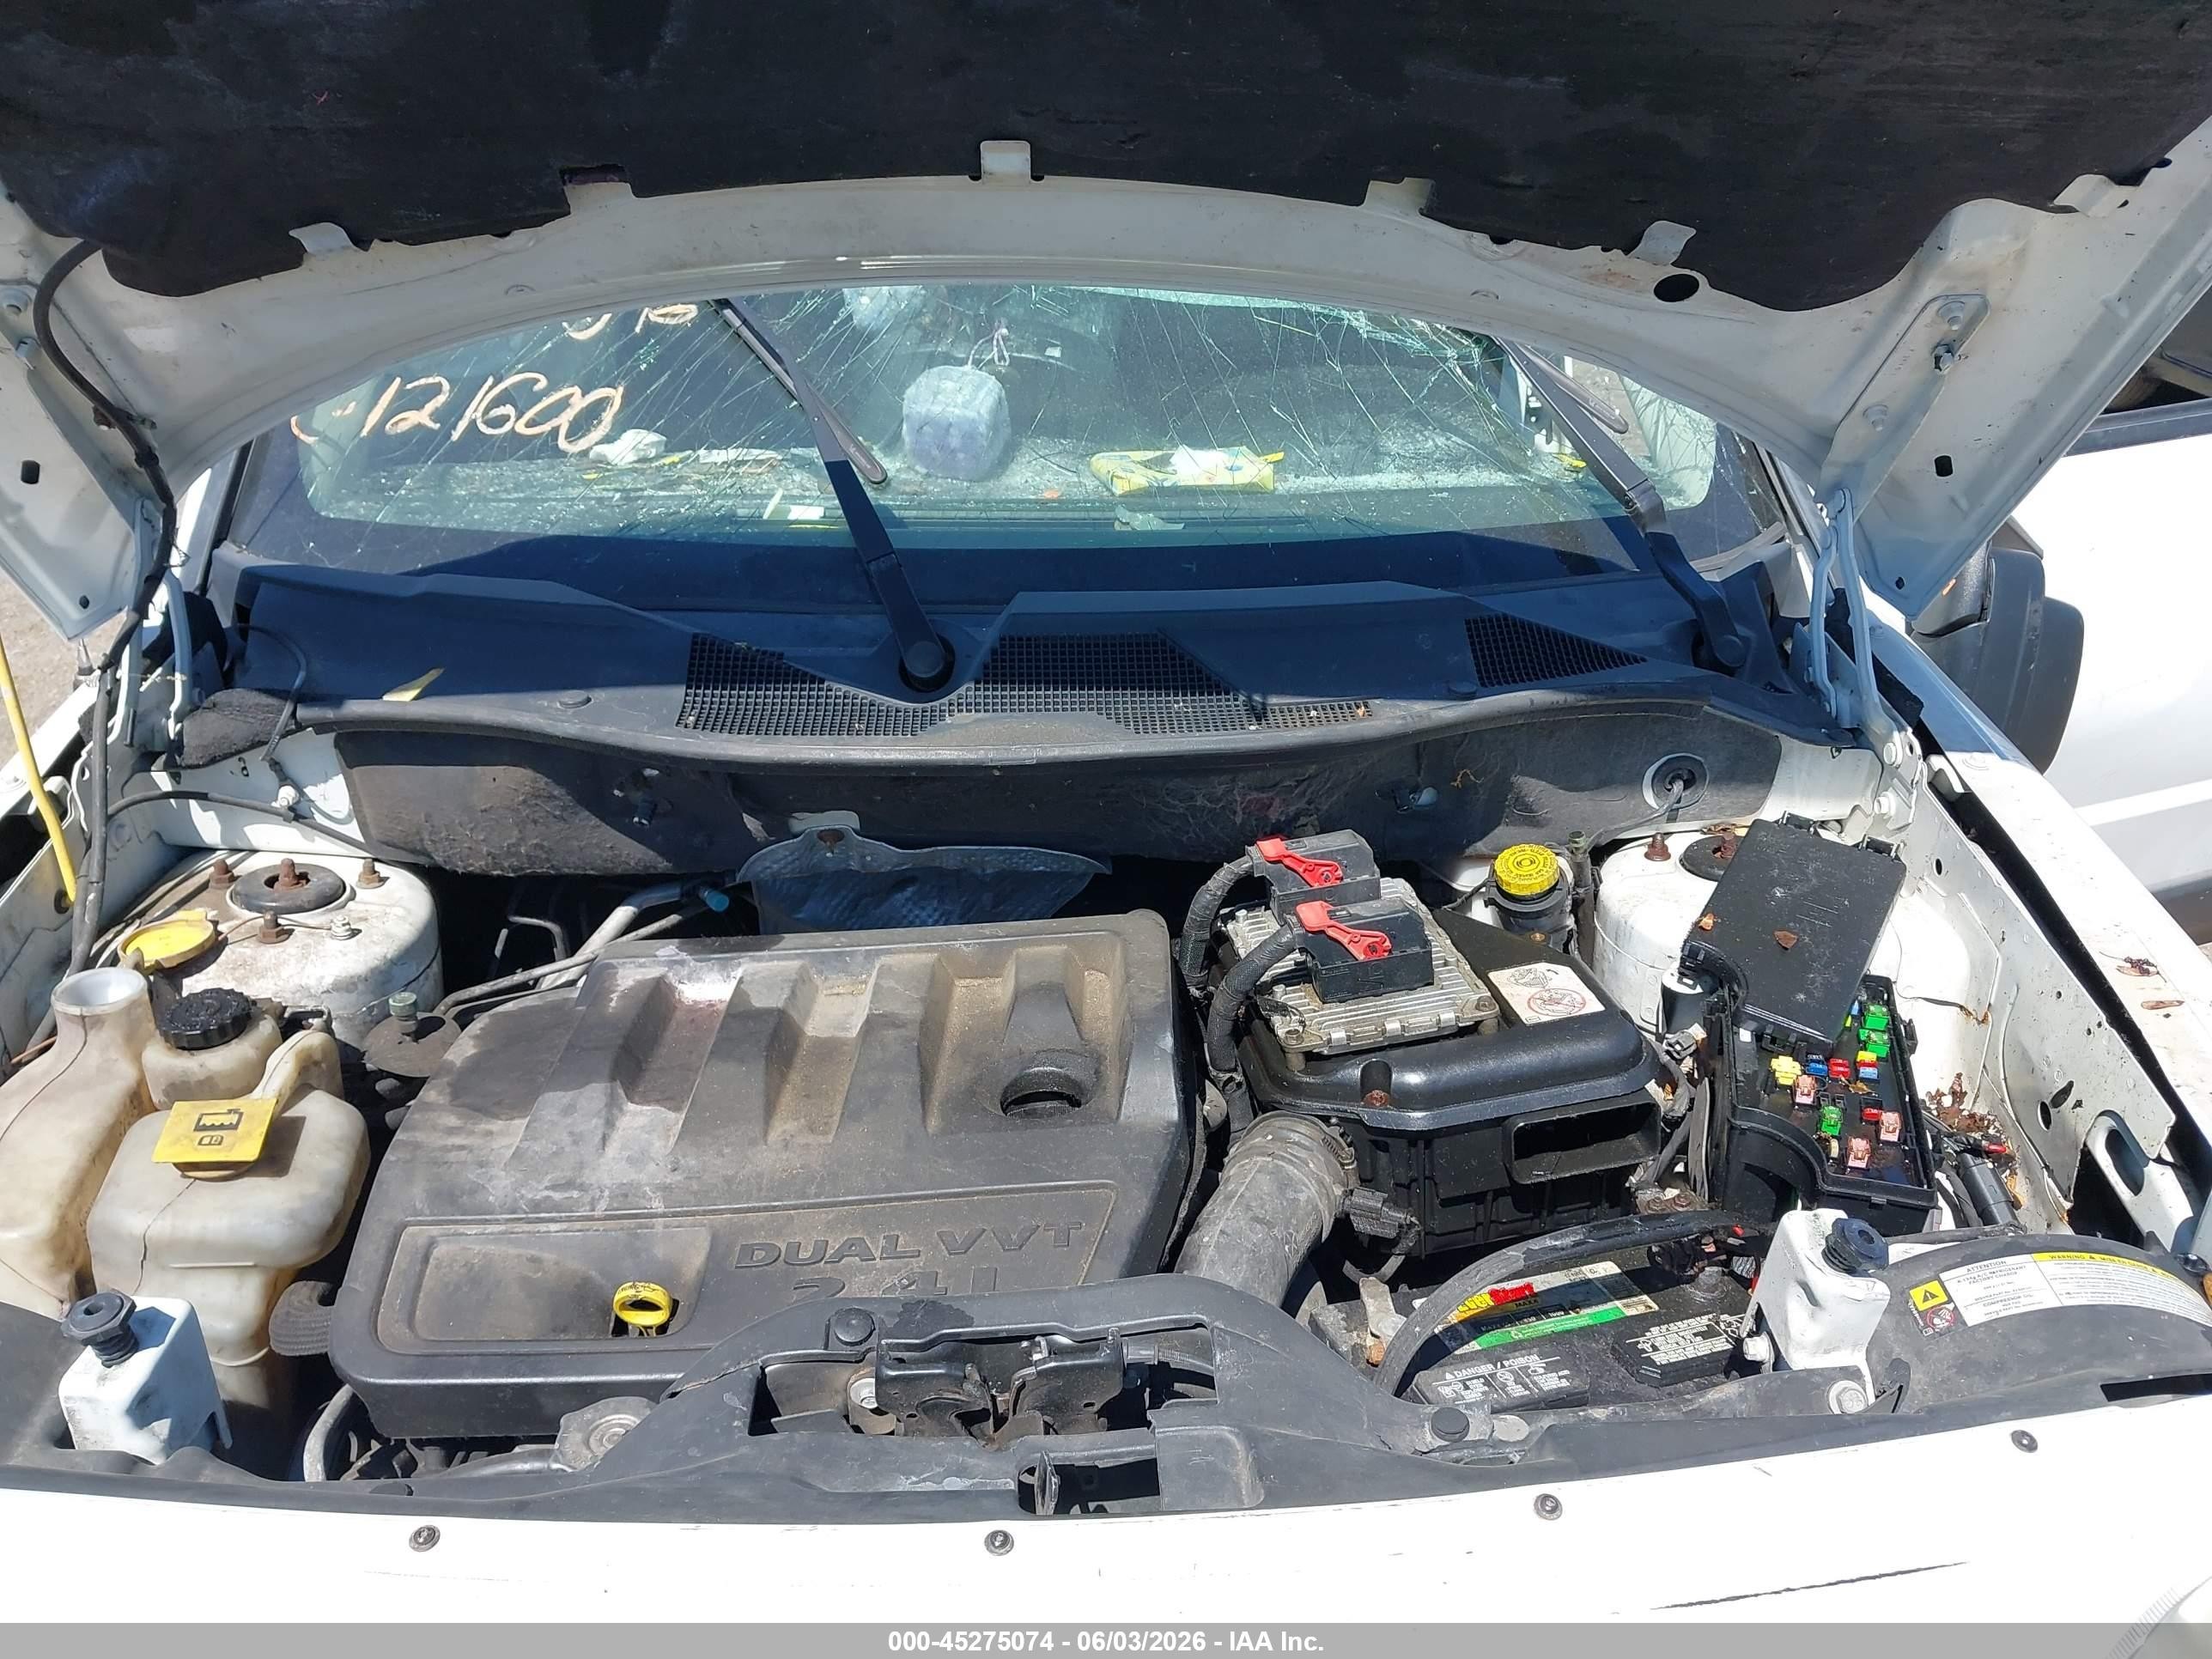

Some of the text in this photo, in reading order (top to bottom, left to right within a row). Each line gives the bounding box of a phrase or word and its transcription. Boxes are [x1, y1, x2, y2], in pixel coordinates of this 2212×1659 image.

[735, 1221, 1082, 1269] DUAL VVT
[1966, 1260, 2007, 1273] ATTENTION
[1454, 1364, 1495, 1379] DANGER
[1502, 1353, 1540, 1369] POISON
